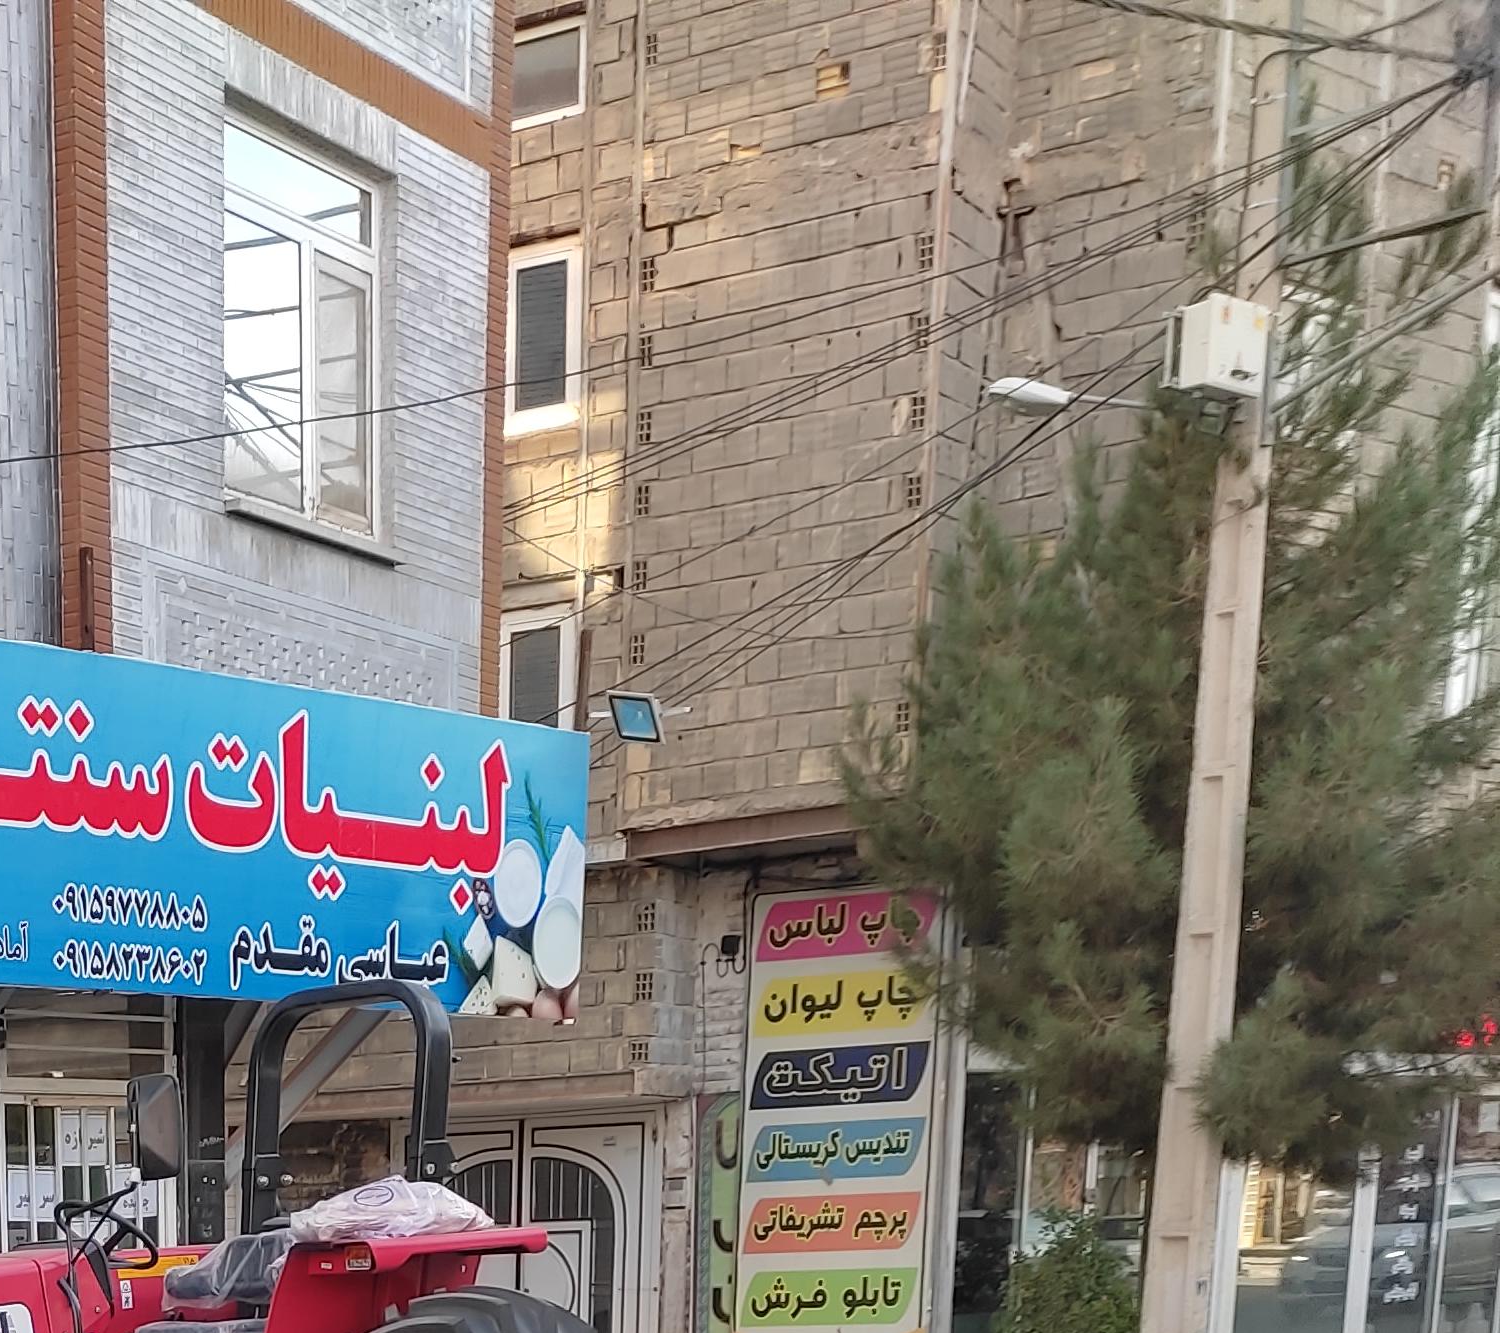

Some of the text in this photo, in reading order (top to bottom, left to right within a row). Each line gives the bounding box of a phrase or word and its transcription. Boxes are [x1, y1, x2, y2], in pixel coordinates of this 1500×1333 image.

[186, 709, 512, 915] لبنیات
[52, 882, 207, 932] ۰۹۱۵۹۷۷۸۸۰۵
[769, 903, 847, 949] لباس
[53, 938, 207, 985] ۰۹۱۵۸۲۳۸۶۰۲
[229, 915, 449, 990] عباسی مقدم
[764, 976, 916, 1024] چاپ لیوان
[763, 1047, 907, 1102] اتیکت
[756, 1128, 911, 1172] تندیس کریستالی
[754, 1201, 908, 1241] پرچم تشریفاتی
[751, 1275, 902, 1319] تابلو فرش
